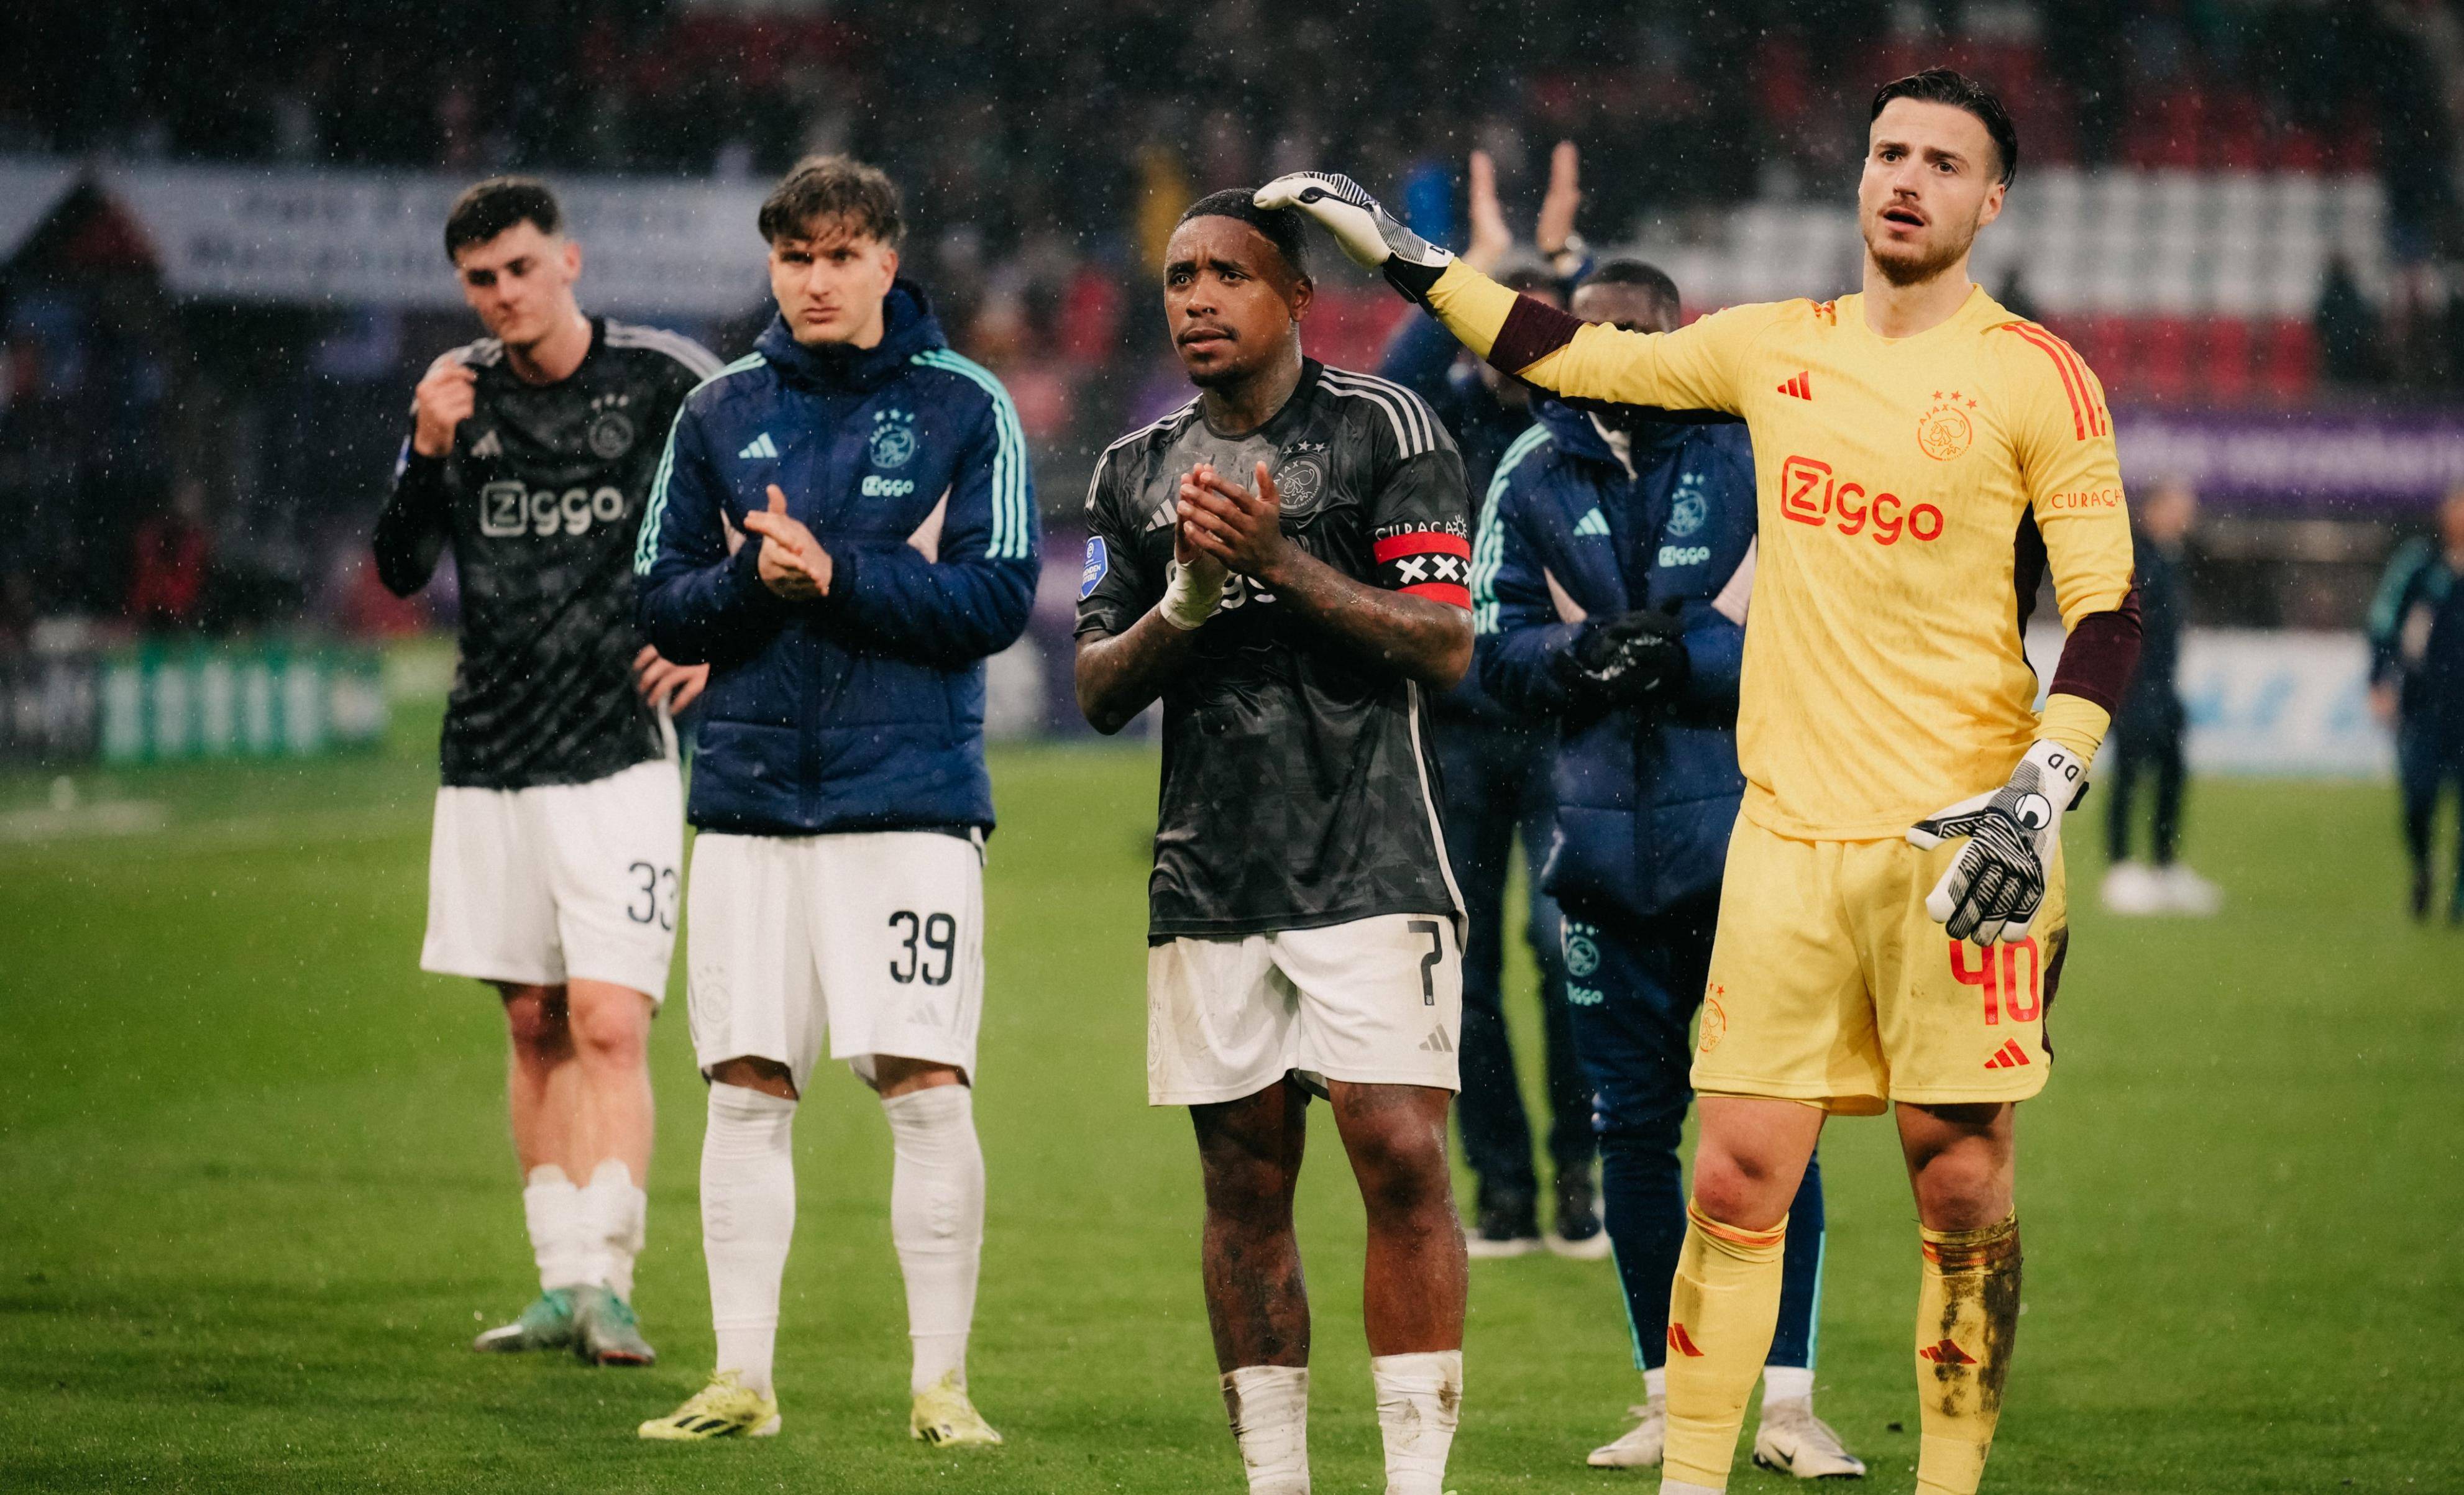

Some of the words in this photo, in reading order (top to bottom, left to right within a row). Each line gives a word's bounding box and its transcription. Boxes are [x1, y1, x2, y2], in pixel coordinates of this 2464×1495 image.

[1780, 455, 1944, 546] Ziggo
[2051, 488, 2122, 509] CURAÇA
[888, 910, 956, 986] 39
[1407, 920, 1442, 1006] 7
[1949, 935, 2040, 1025] 40
